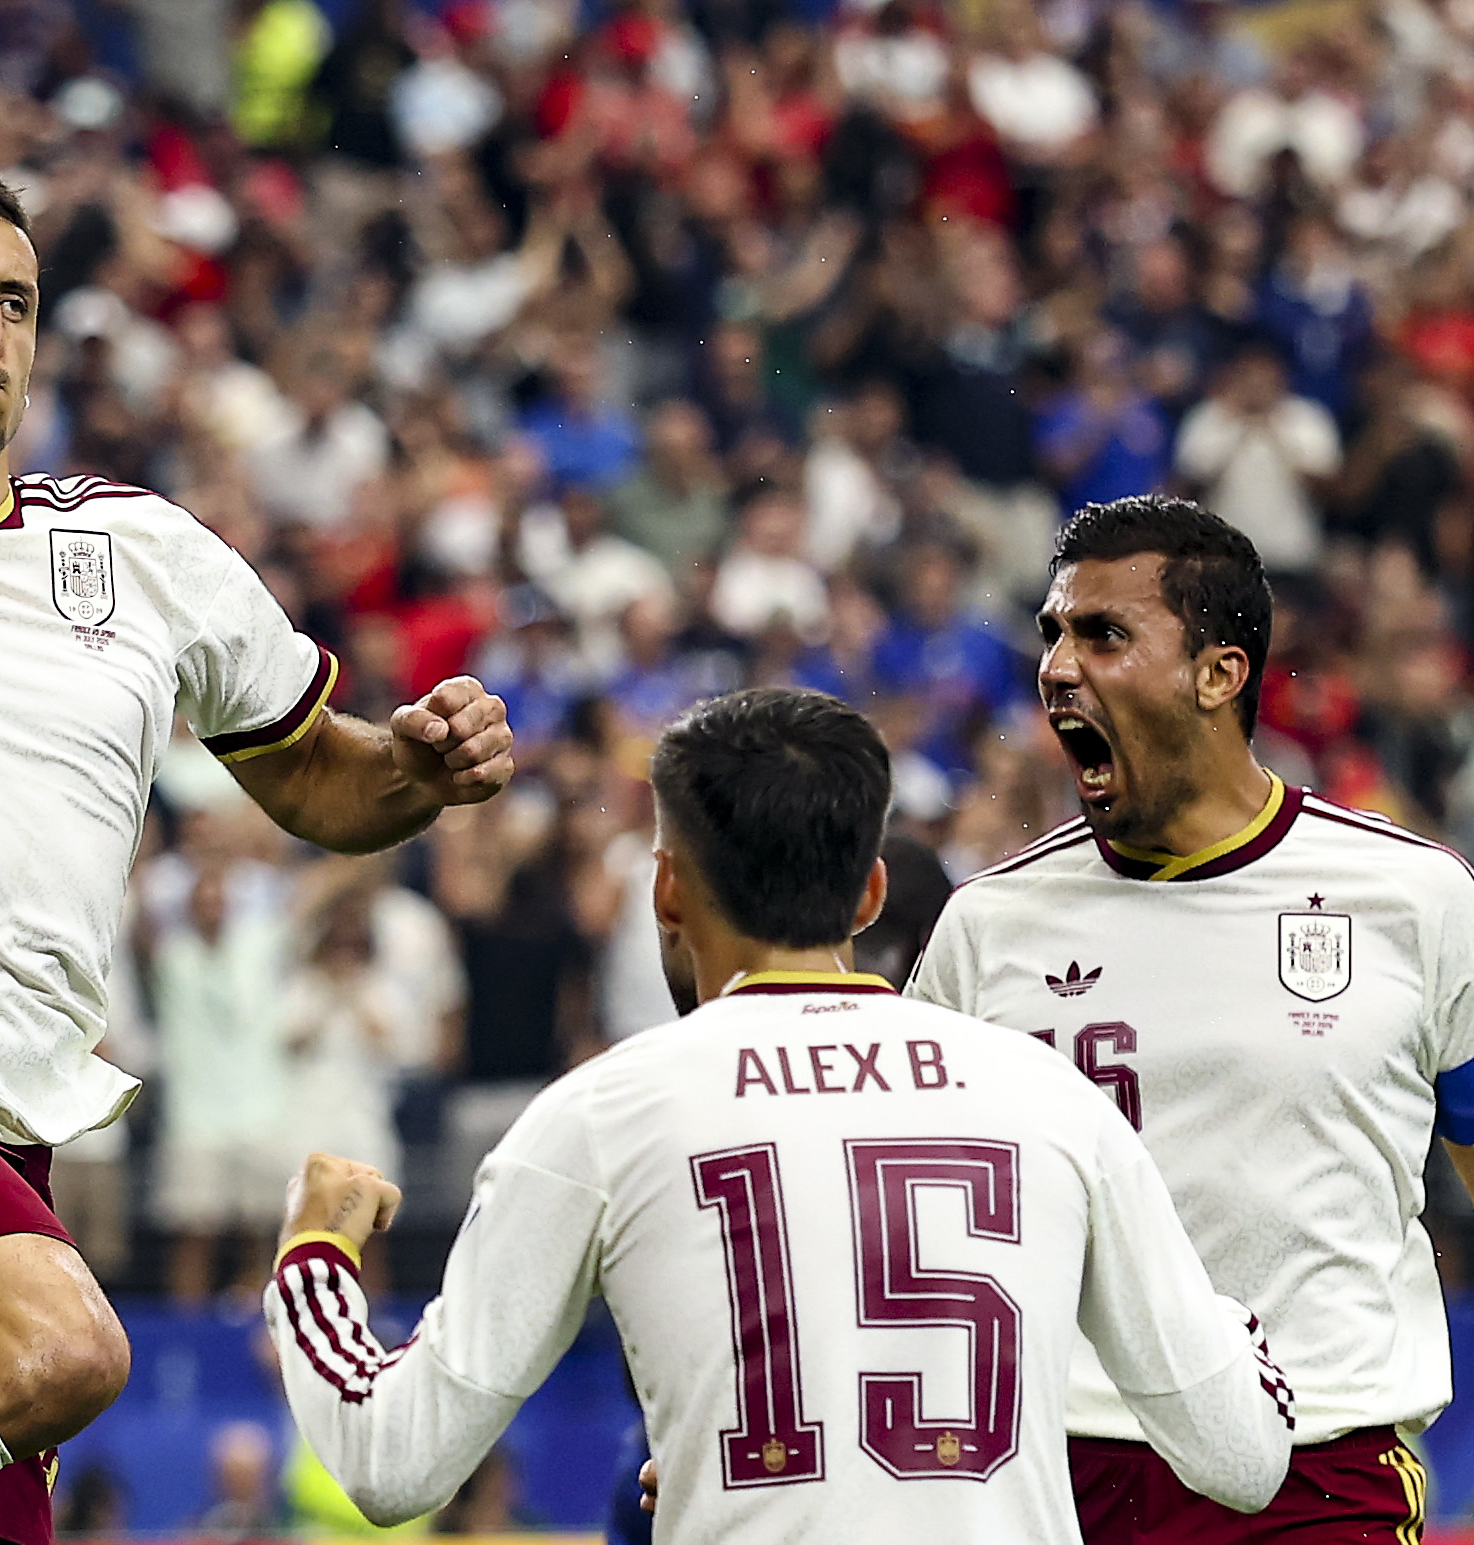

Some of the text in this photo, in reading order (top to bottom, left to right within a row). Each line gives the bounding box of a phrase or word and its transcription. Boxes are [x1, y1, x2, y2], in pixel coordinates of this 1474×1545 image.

[735, 1039, 966, 1098] ALEX B.
[1028, 1021, 1142, 1134] 6
[689, 1138, 1023, 1489] 15
